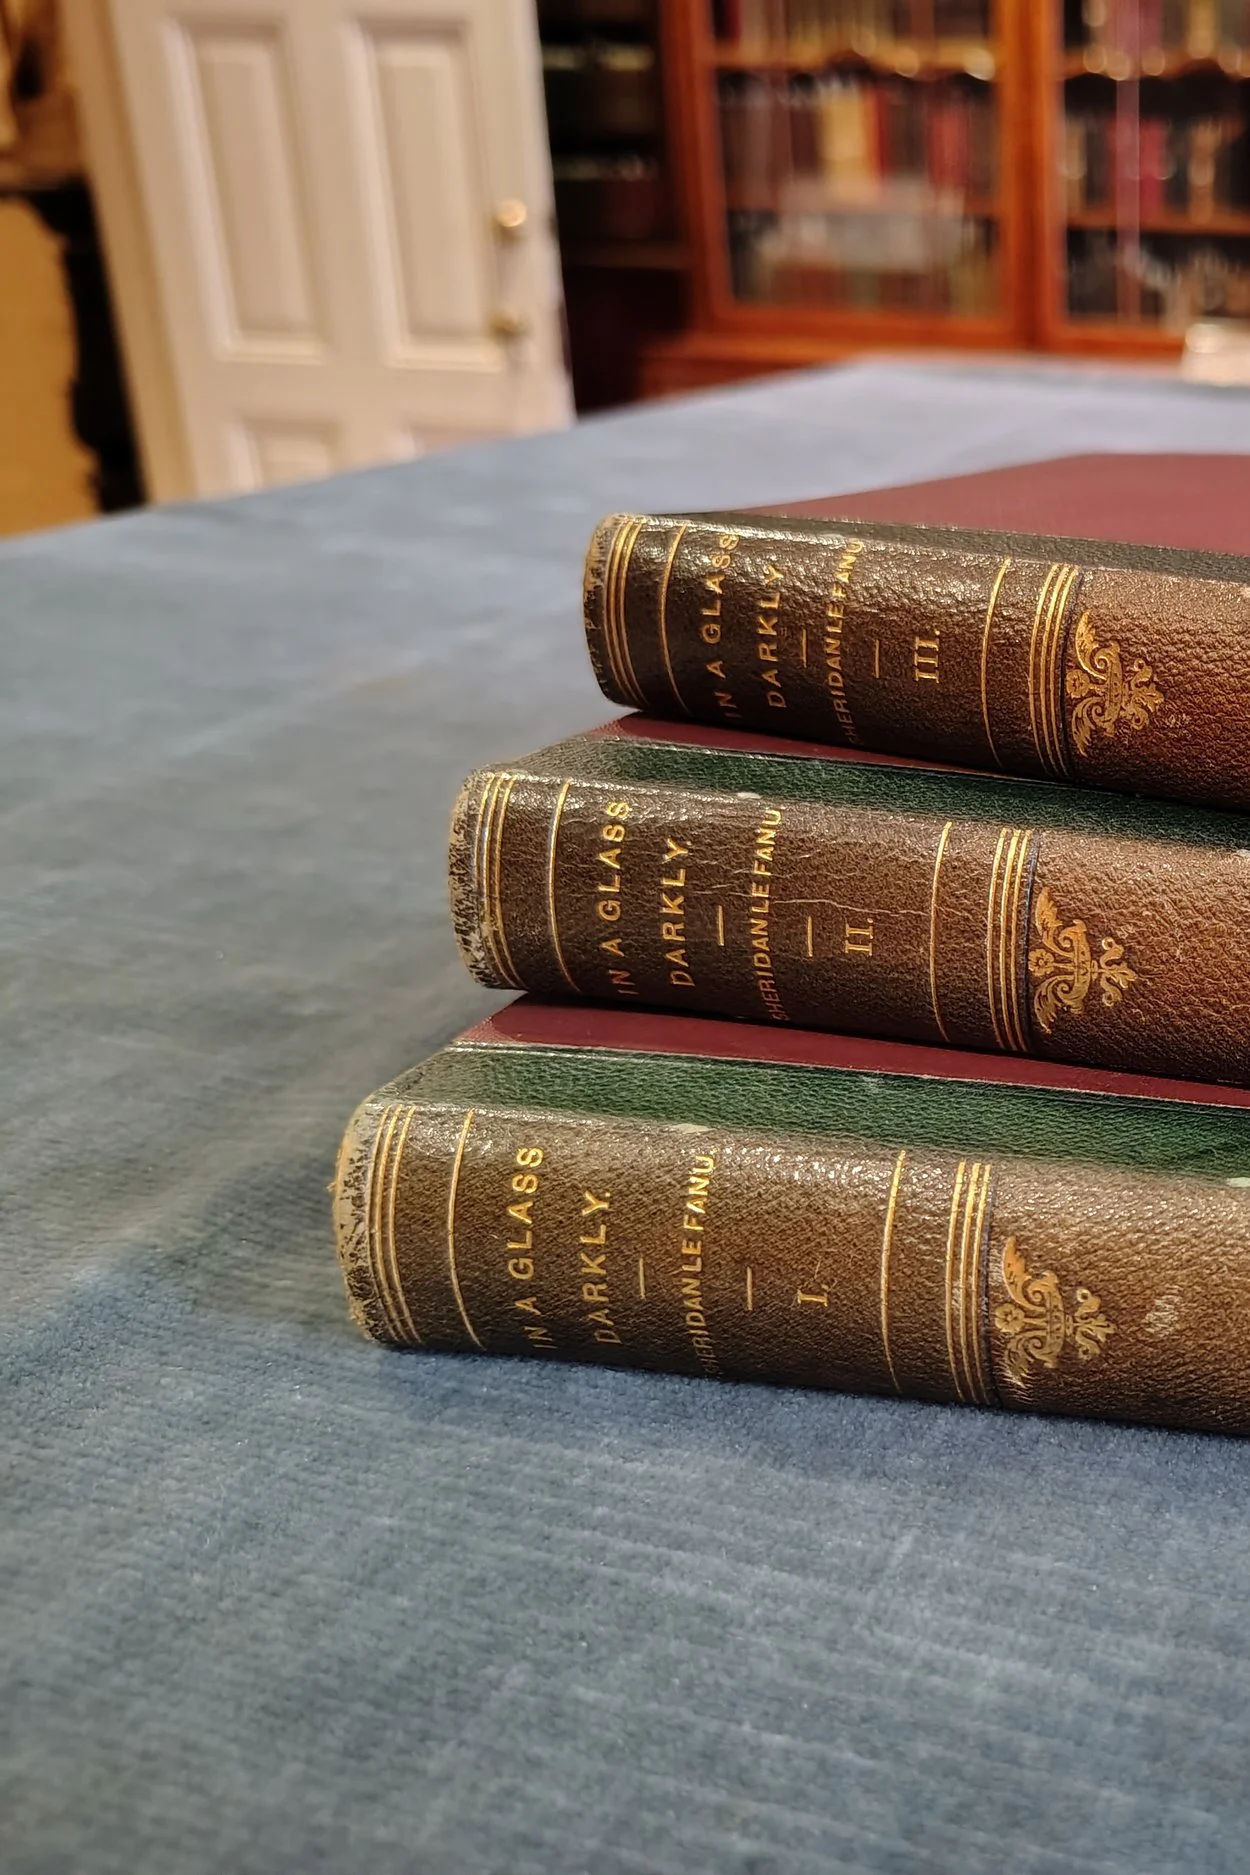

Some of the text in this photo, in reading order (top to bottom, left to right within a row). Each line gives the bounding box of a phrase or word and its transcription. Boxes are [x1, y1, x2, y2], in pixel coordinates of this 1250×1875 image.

[701, 533, 742, 719] IN A GLASS
[826, 602, 845, 633] LE
[913, 629, 940, 684] III.
[598, 800, 639, 996] IN A GLASS
[660, 837, 696, 987] DARKLY.
[751, 882, 770, 915] LE
[844, 917, 874, 957] II.
[506, 1146, 558, 1350] IN A GLASS
[579, 1191, 622, 1345] DARKLY.
[681, 1239, 702, 1272] LE
